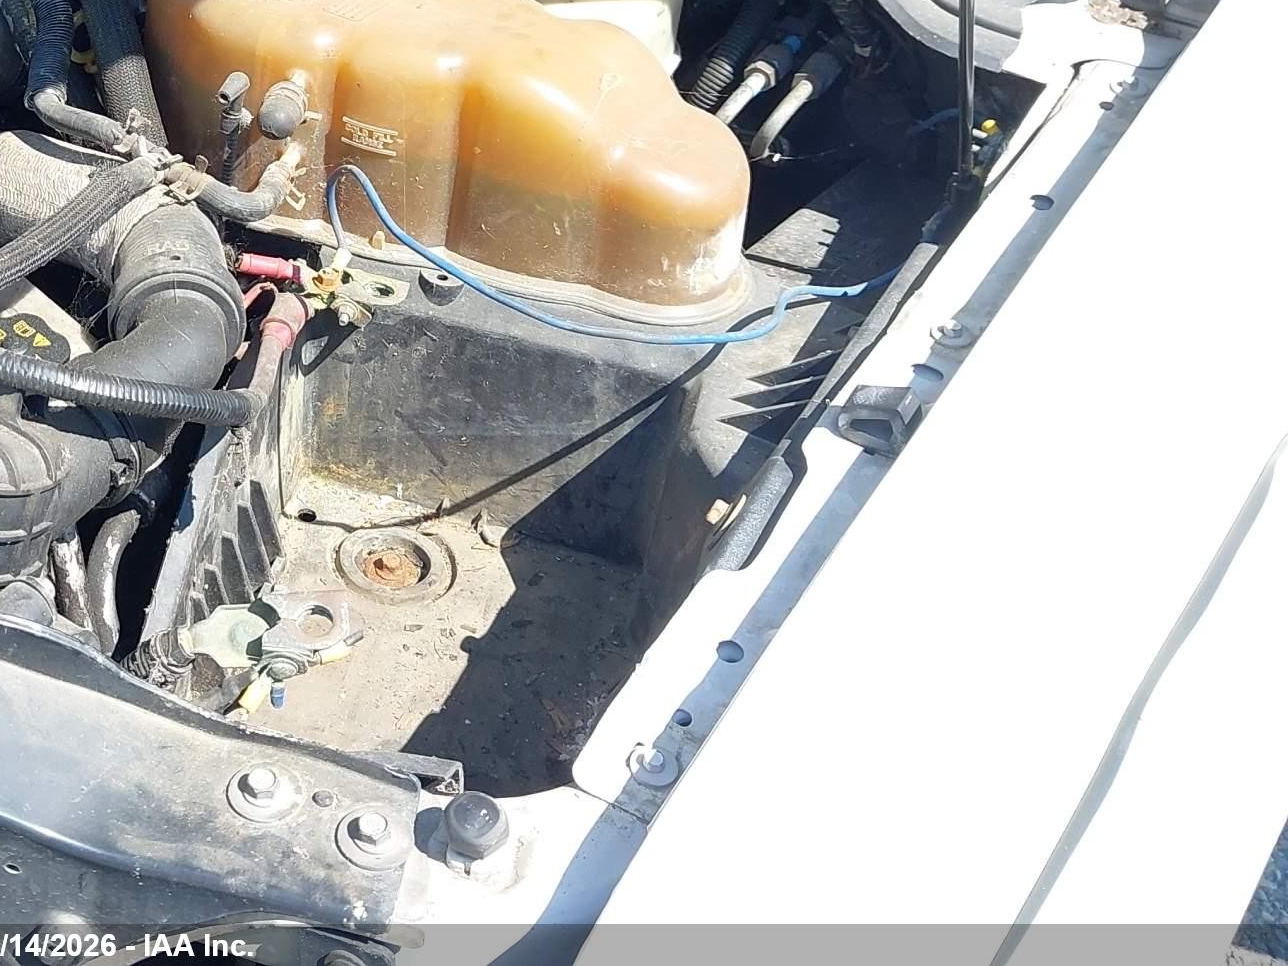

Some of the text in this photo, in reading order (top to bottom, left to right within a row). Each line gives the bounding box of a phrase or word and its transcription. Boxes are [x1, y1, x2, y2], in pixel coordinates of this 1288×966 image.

[345, 123, 394, 144] COLD FILL
[352, 133, 384, 150] RANGE
